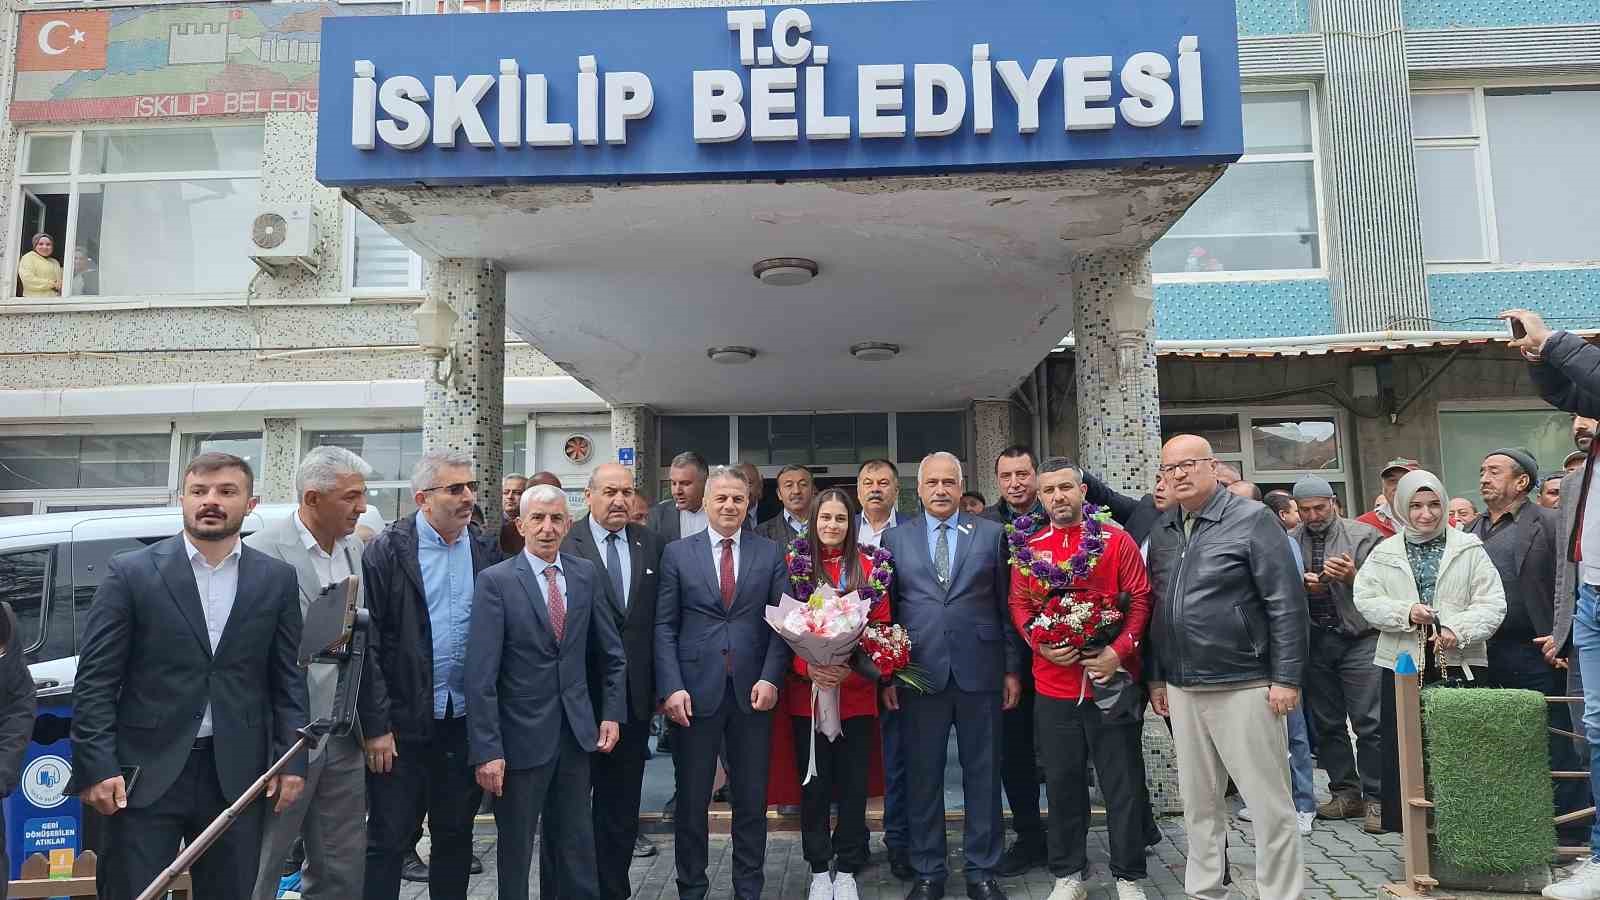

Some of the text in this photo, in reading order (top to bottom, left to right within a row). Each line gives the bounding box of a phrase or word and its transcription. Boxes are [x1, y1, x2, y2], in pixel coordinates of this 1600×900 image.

[727, 8, 829, 66] T.C.
[351, 35, 1204, 150] İSKİLİP BELEDİYESİ
[35, 838, 66, 846] ATIKLAR
